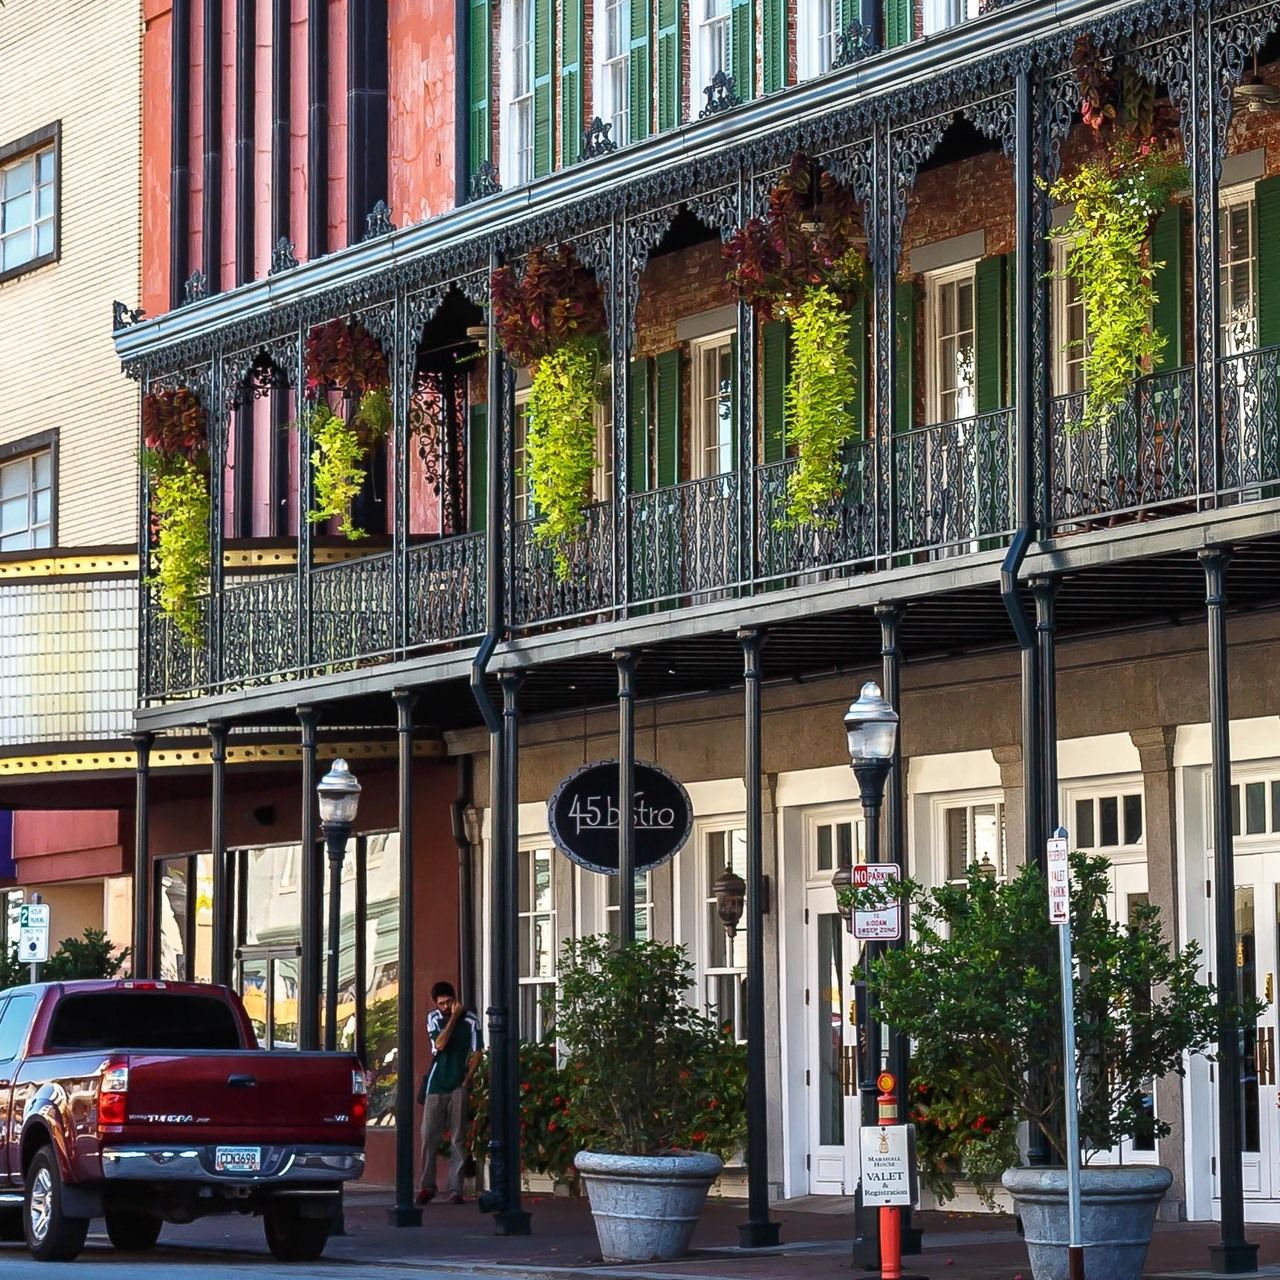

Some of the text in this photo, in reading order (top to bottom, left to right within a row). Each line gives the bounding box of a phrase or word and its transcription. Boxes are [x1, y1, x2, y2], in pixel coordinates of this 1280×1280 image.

[568, 794, 601, 835] 45
[854, 870, 867, 883] NO
[21, 909, 28, 924] 2
[867, 1172, 904, 1181] VALET
[864, 1189, 908, 1197] Registration
